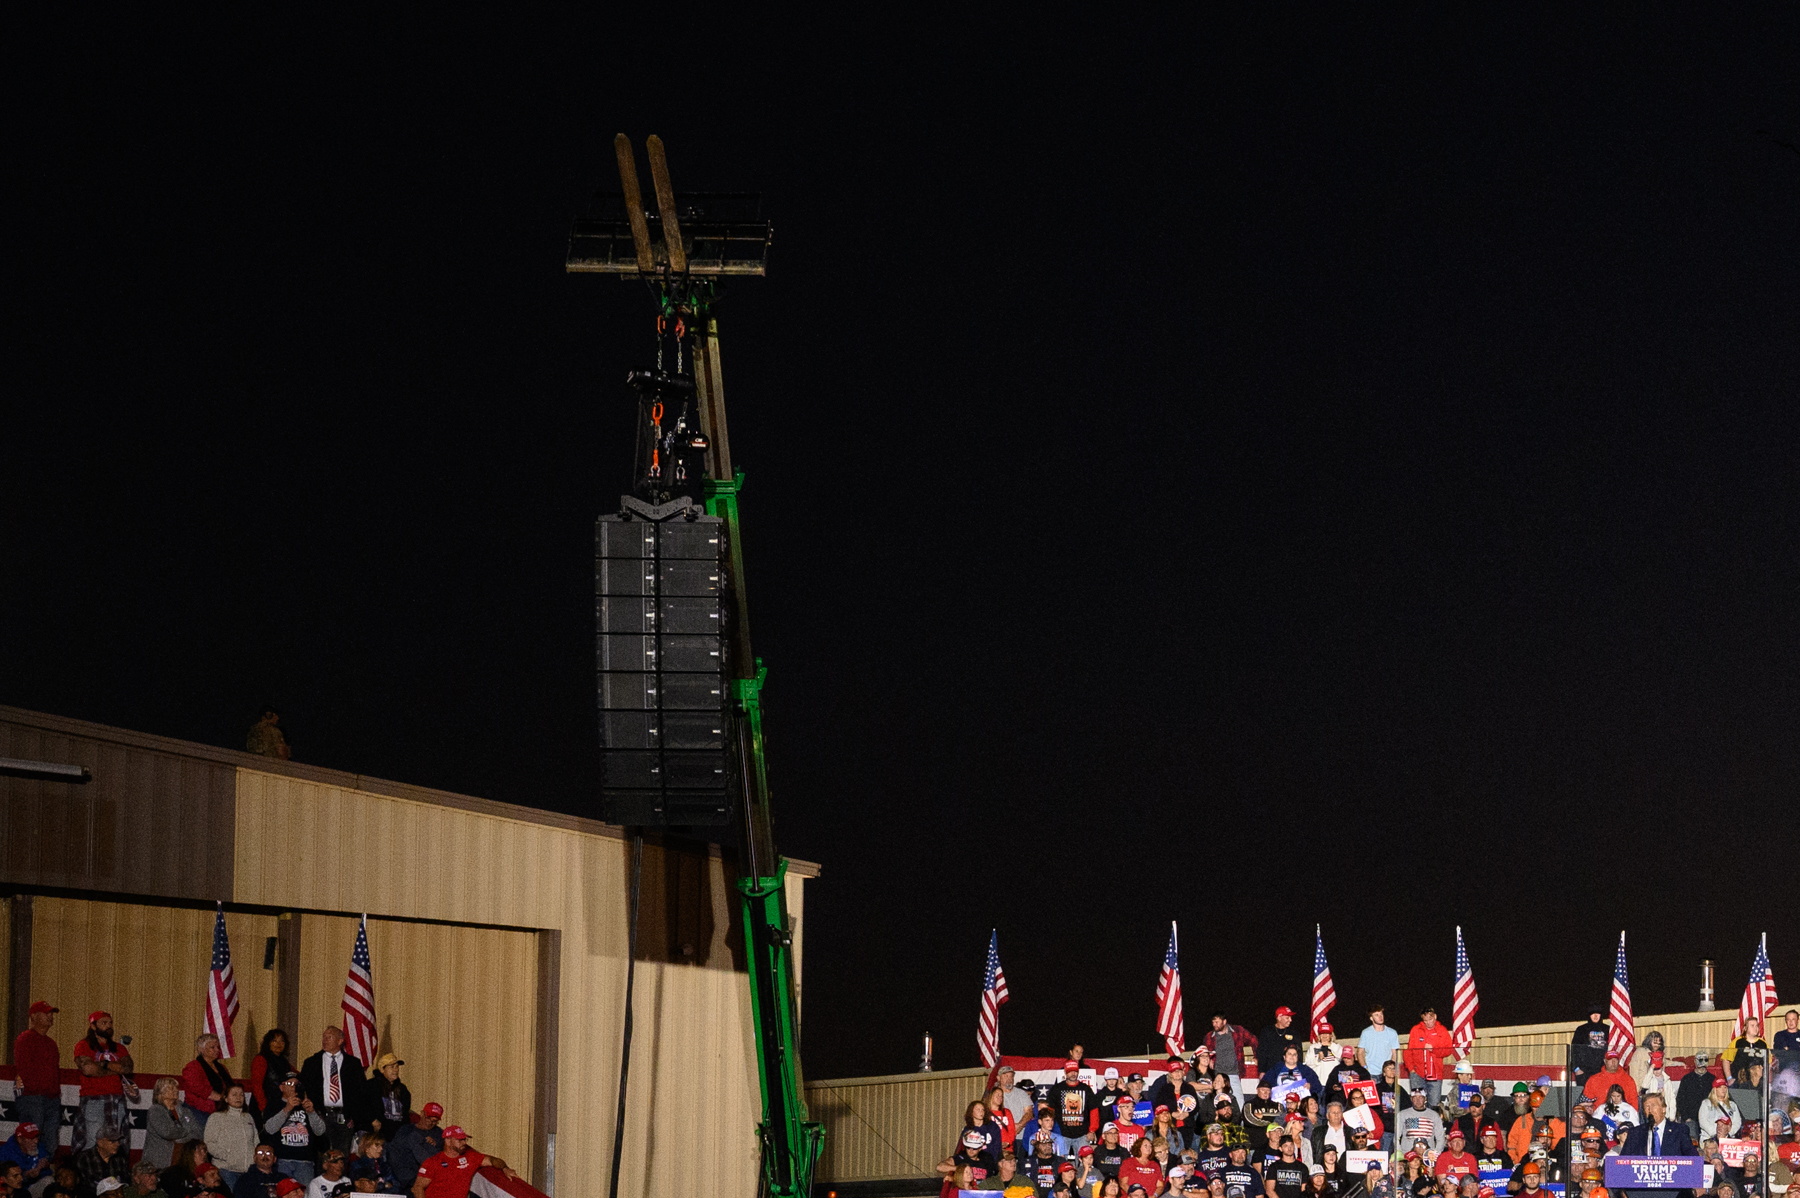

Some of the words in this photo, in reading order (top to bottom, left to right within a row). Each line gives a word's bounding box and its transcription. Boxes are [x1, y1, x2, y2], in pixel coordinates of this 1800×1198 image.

[1722, 1150, 1744, 1160] STE
[1201, 1162, 1227, 1170] TRUMP
[1631, 1165, 1677, 1173] TRUMP
